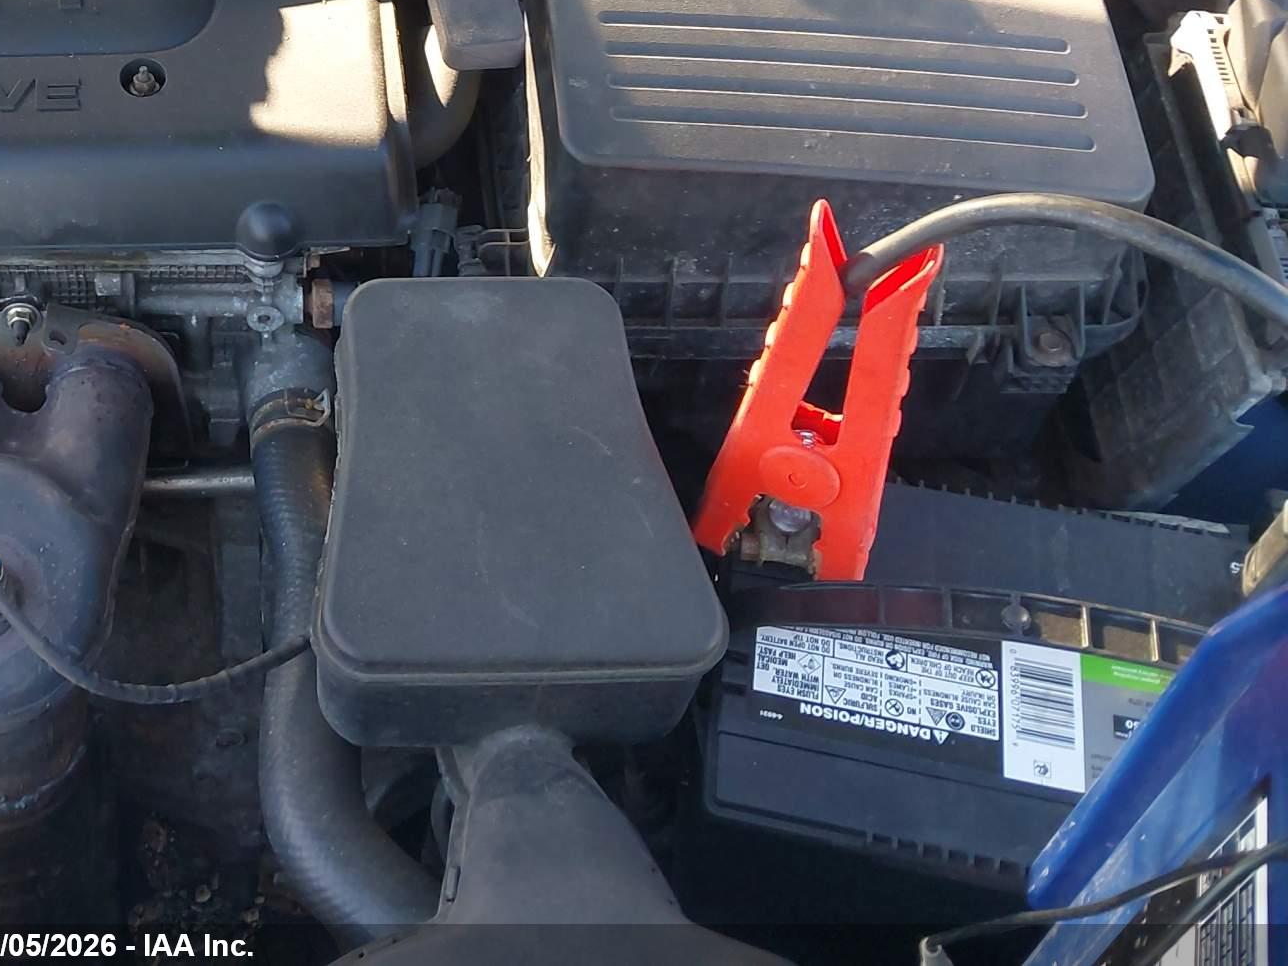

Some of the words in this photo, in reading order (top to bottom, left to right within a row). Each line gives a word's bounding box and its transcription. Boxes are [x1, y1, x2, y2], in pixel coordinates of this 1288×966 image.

[789, 640, 806, 650] OPEN
[806, 636, 819, 645] NOT
[807, 643, 819, 652] NOT
[821, 645, 831, 654] DO
[779, 650, 796, 660] HELP
[856, 653, 867, 661] ALL
[868, 655, 883, 664] READ
[758, 655, 788, 667] MEDICAL
[757, 663, 770, 671] GET
[953, 665, 975, 676] REACH
[801, 673, 819, 683] WITH
[855, 668, 878, 679] SEVERE
[944, 671, 957, 680] OUT
[959, 674, 974, 683] KEEP
[771, 675, 820, 691] IMMEDIATELY
[844, 673, 878, 686] BLINDNESS
[777, 685, 795, 696] EYES
[844, 682, 864, 691] CAUSE
[797, 689, 819, 700] FLUSH
[861, 693, 877, 702] ACID
[923, 689, 959, 701] BLINDNESS
[843, 698, 877, 713] SULFURIC
[930, 697, 954, 710] GASES
[961, 696, 981, 706] CAUSE
[907, 706, 916, 715] NO
[956, 703, 996, 718] EXPLOSIVE
[799, 702, 932, 741] DANGER/POISON
[971, 724, 996, 737] SHIELD
